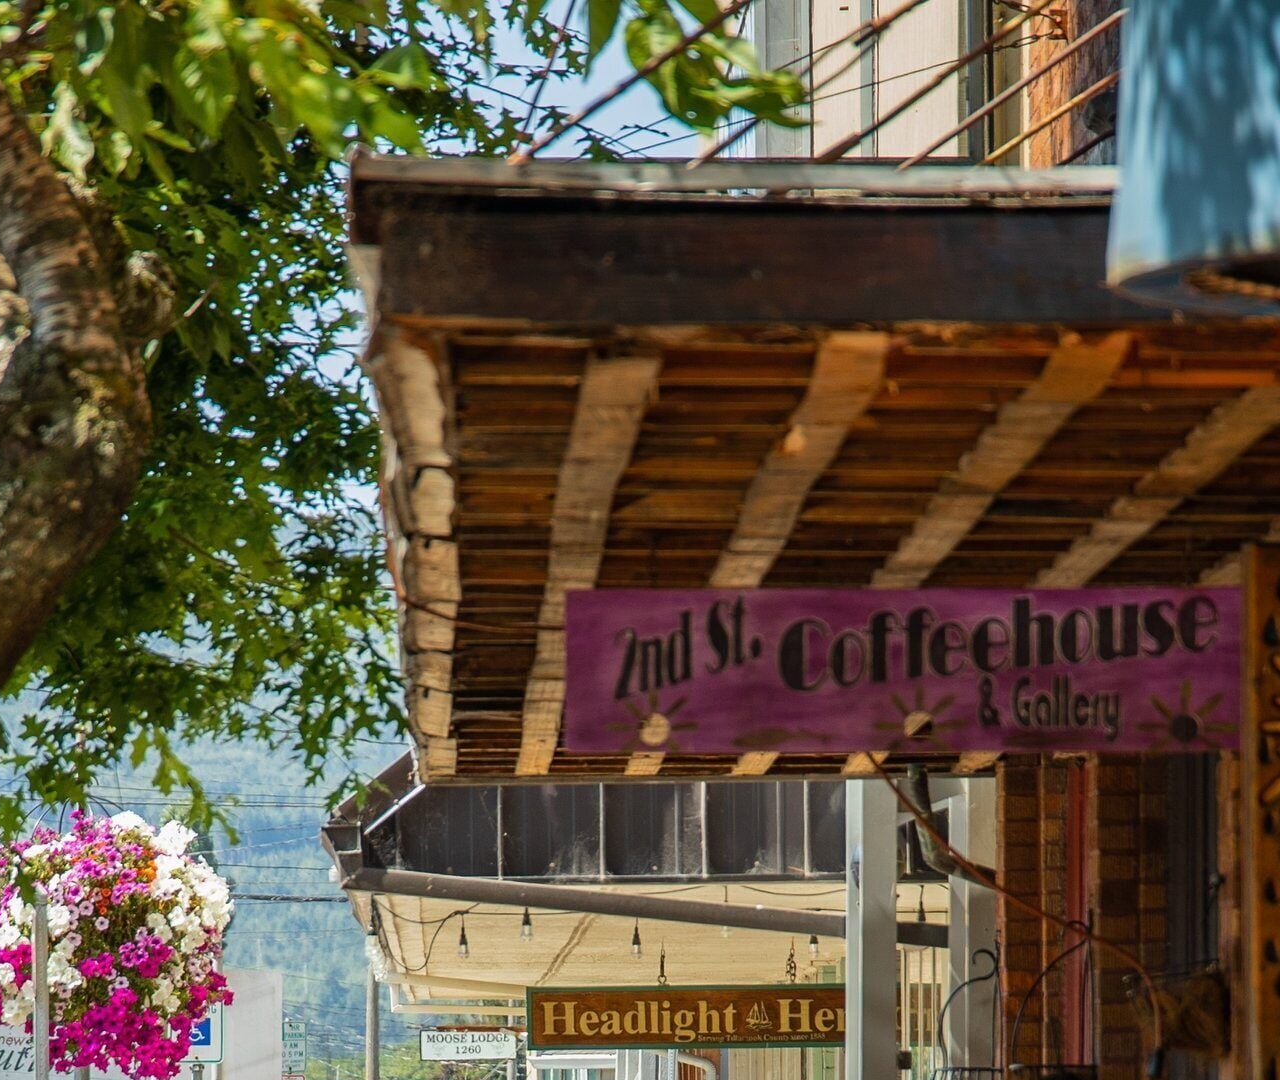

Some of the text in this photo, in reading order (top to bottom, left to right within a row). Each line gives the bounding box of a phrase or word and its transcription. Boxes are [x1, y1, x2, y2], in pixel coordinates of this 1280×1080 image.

[614, 593, 1219, 700] 2nd St. Coffeehouse
[977, 672, 1120, 738] & Gallery
[426, 1033, 510, 1044] MOOSE LODGE
[539, 1000, 737, 1043] Headlight
[455, 1045, 482, 1054] 1260
